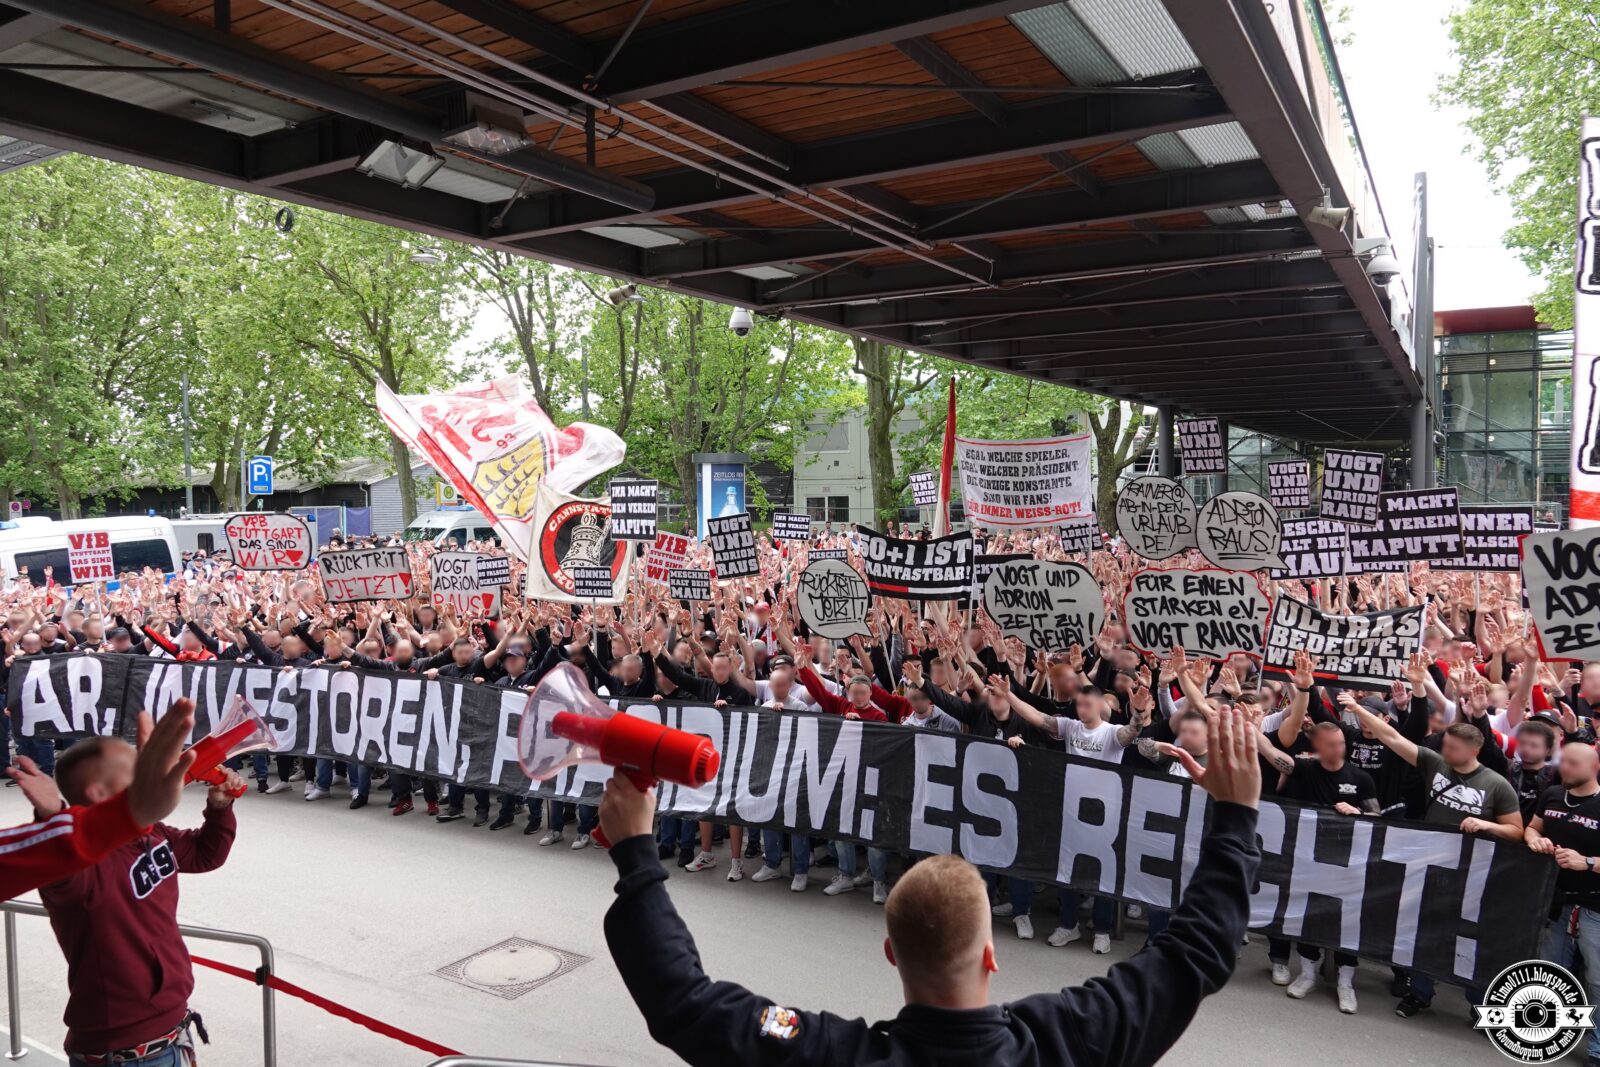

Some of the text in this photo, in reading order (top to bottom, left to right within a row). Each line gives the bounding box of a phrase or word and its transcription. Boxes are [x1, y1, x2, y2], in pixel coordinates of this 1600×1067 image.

[1178, 420, 1217, 434] VOGT
[1180, 433, 1220, 448] UND
[966, 448, 986, 460] EGAL
[987, 452, 1023, 462] WELCHE
[1184, 449, 1222, 458] ADRION
[980, 464, 1019, 477] WELCHER
[1184, 458, 1225, 470] RAUS
[1269, 462, 1306, 474] VOGT
[1326, 453, 1382, 472] VOGT
[910, 473, 932, 482] VOGT
[980, 478, 1010, 492] EINZIGE
[1012, 476, 1072, 492] KONSTANTE
[1270, 474, 1308, 487] UND
[1324, 470, 1380, 492] UND
[612, 485, 656, 496] IHR MACHT
[912, 481, 935, 492] UND
[1272, 488, 1308, 496] ADRION
[1003, 494, 1020, 506] WIR
[1023, 493, 1052, 505] FANS!
[1272, 496, 1309, 506] RAUS
[1323, 488, 1378, 504] ADRION
[1386, 494, 1456, 512] MACHT
[612, 502, 656, 514] DEN VEREIN
[980, 504, 1013, 518] IMMER
[1015, 502, 1082, 518] WEISS-ROT!
[1322, 501, 1377, 520] RAUS
[612, 519, 656, 535] KAPUTT
[708, 516, 749, 534] VOGT
[1131, 514, 1192, 534] URLAUB
[1390, 514, 1459, 530] VEREIN
[68, 532, 110, 550] VfB
[228, 526, 304, 540] STUTTGART
[711, 530, 754, 552] UND
[774, 528, 808, 538] KAPUTT
[1207, 527, 1276, 555] RAUS!
[239, 540, 296, 550] DAS SIND
[655, 532, 688, 554] VfB
[1352, 534, 1460, 558] KAPUTT
[715, 548, 755, 562] ADRION
[809, 551, 847, 560] MESCHKE
[924, 538, 972, 566] IST
[72, 556, 112, 566] DAS SIND
[434, 558, 470, 574] VOGT
[648, 558, 663, 566] DAS
[716, 558, 758, 576] RAUS
[72, 565, 113, 580] WIR
[574, 568, 610, 578] GÖNNER
[647, 565, 669, 582] WI
[670, 570, 709, 578] MESCHKE
[996, 565, 1040, 586] VOGT
[1046, 569, 1080, 588] UND
[326, 572, 412, 599] JETZT!
[576, 588, 612, 596] SCHLANGE
[1136, 574, 1244, 596] FÜR EINEN
[671, 587, 710, 600] MAUL
[994, 586, 1053, 611] ADRION
[1132, 596, 1222, 617] STARKEN
[998, 613, 1084, 630] ZEIT ZU
[1276, 599, 1420, 639] ULTRAS
[1132, 620, 1265, 653] VOGT RAUS!
[1270, 624, 1420, 658] BEDEUTET
[144, 662, 471, 783] INVESTOREN,
[910, 733, 1019, 868] ES
